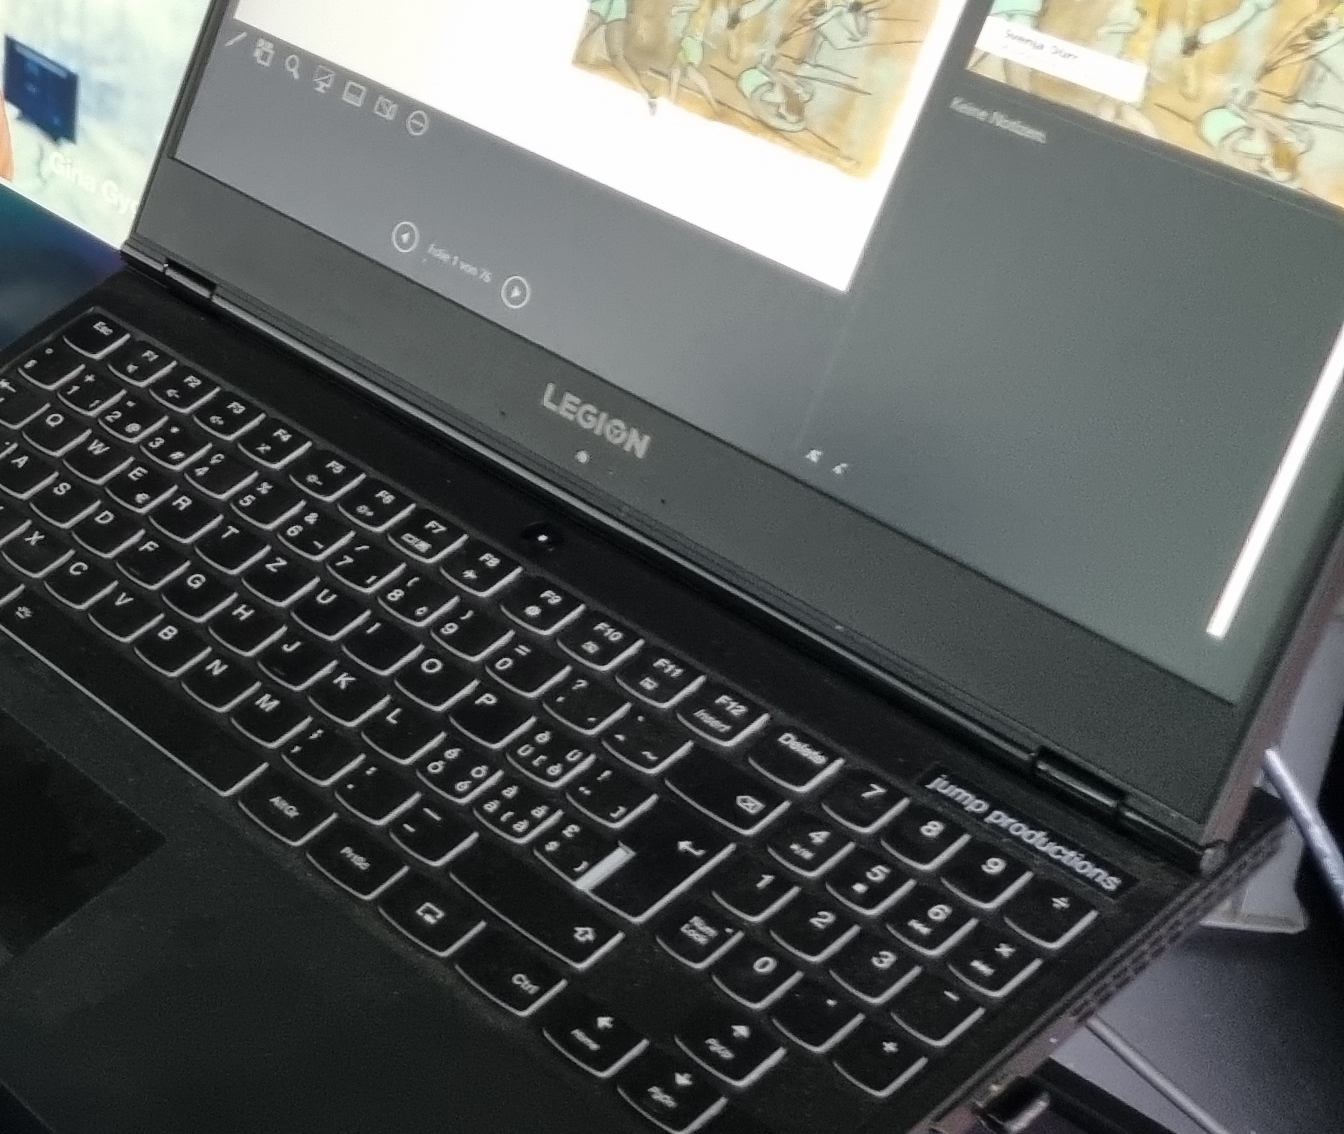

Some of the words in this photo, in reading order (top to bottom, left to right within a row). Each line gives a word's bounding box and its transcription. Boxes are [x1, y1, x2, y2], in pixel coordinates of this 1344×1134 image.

[49, 151, 96, 193] Gina
[92, 320, 113, 336] Esc
[142, 349, 159, 362] F1
[183, 375, 202, 388] F2
[227, 400, 246, 414] F3
[45, 414, 64, 428] Q
[107, 411, 122, 423] 2
[540, 382, 651, 459] LEGION
[149, 437, 165, 449] 3
[273, 429, 292, 442] F4
[87, 440, 110, 455] W
[11, 455, 29, 469] A
[326, 459, 345, 474] F5
[128, 467, 148, 481] E
[195, 466, 210, 477] 4
[53, 482, 71, 497] S
[376, 489, 395, 503] F6
[172, 496, 192, 511] R
[239, 495, 256, 507] 5
[94, 511, 114, 525] D
[424, 520, 447, 534] F7
[24, 531, 44, 546] X
[139, 540, 159, 554] F
[266, 557, 287, 573] Z
[335, 555, 353, 567] 7
[479, 553, 501, 567] F8
[186, 574, 205, 590] G
[316, 589, 337, 604] U
[388, 589, 404, 601] 8
[540, 590, 562, 604] F9
[233, 604, 254, 621] H
[158, 625, 177, 640] B
[440, 622, 459, 635] 9
[594, 622, 623, 641] F10
[206, 659, 227, 675] N
[653, 658, 683, 678] F11
[332, 673, 353, 689] K
[255, 694, 279, 711] M
[475, 692, 497, 707] P
[715, 695, 748, 717] F12
[777, 732, 828, 765] Delete
[861, 783, 887, 800] 7
[919, 820, 944, 837] 8
[925, 774, 990, 813] jump
[984, 810, 1122, 890] productions
[866, 865, 889, 882] 5
[981, 857, 1007, 875] 9
[927, 904, 951, 922] 6
[512, 974, 540, 994] Ctrl
